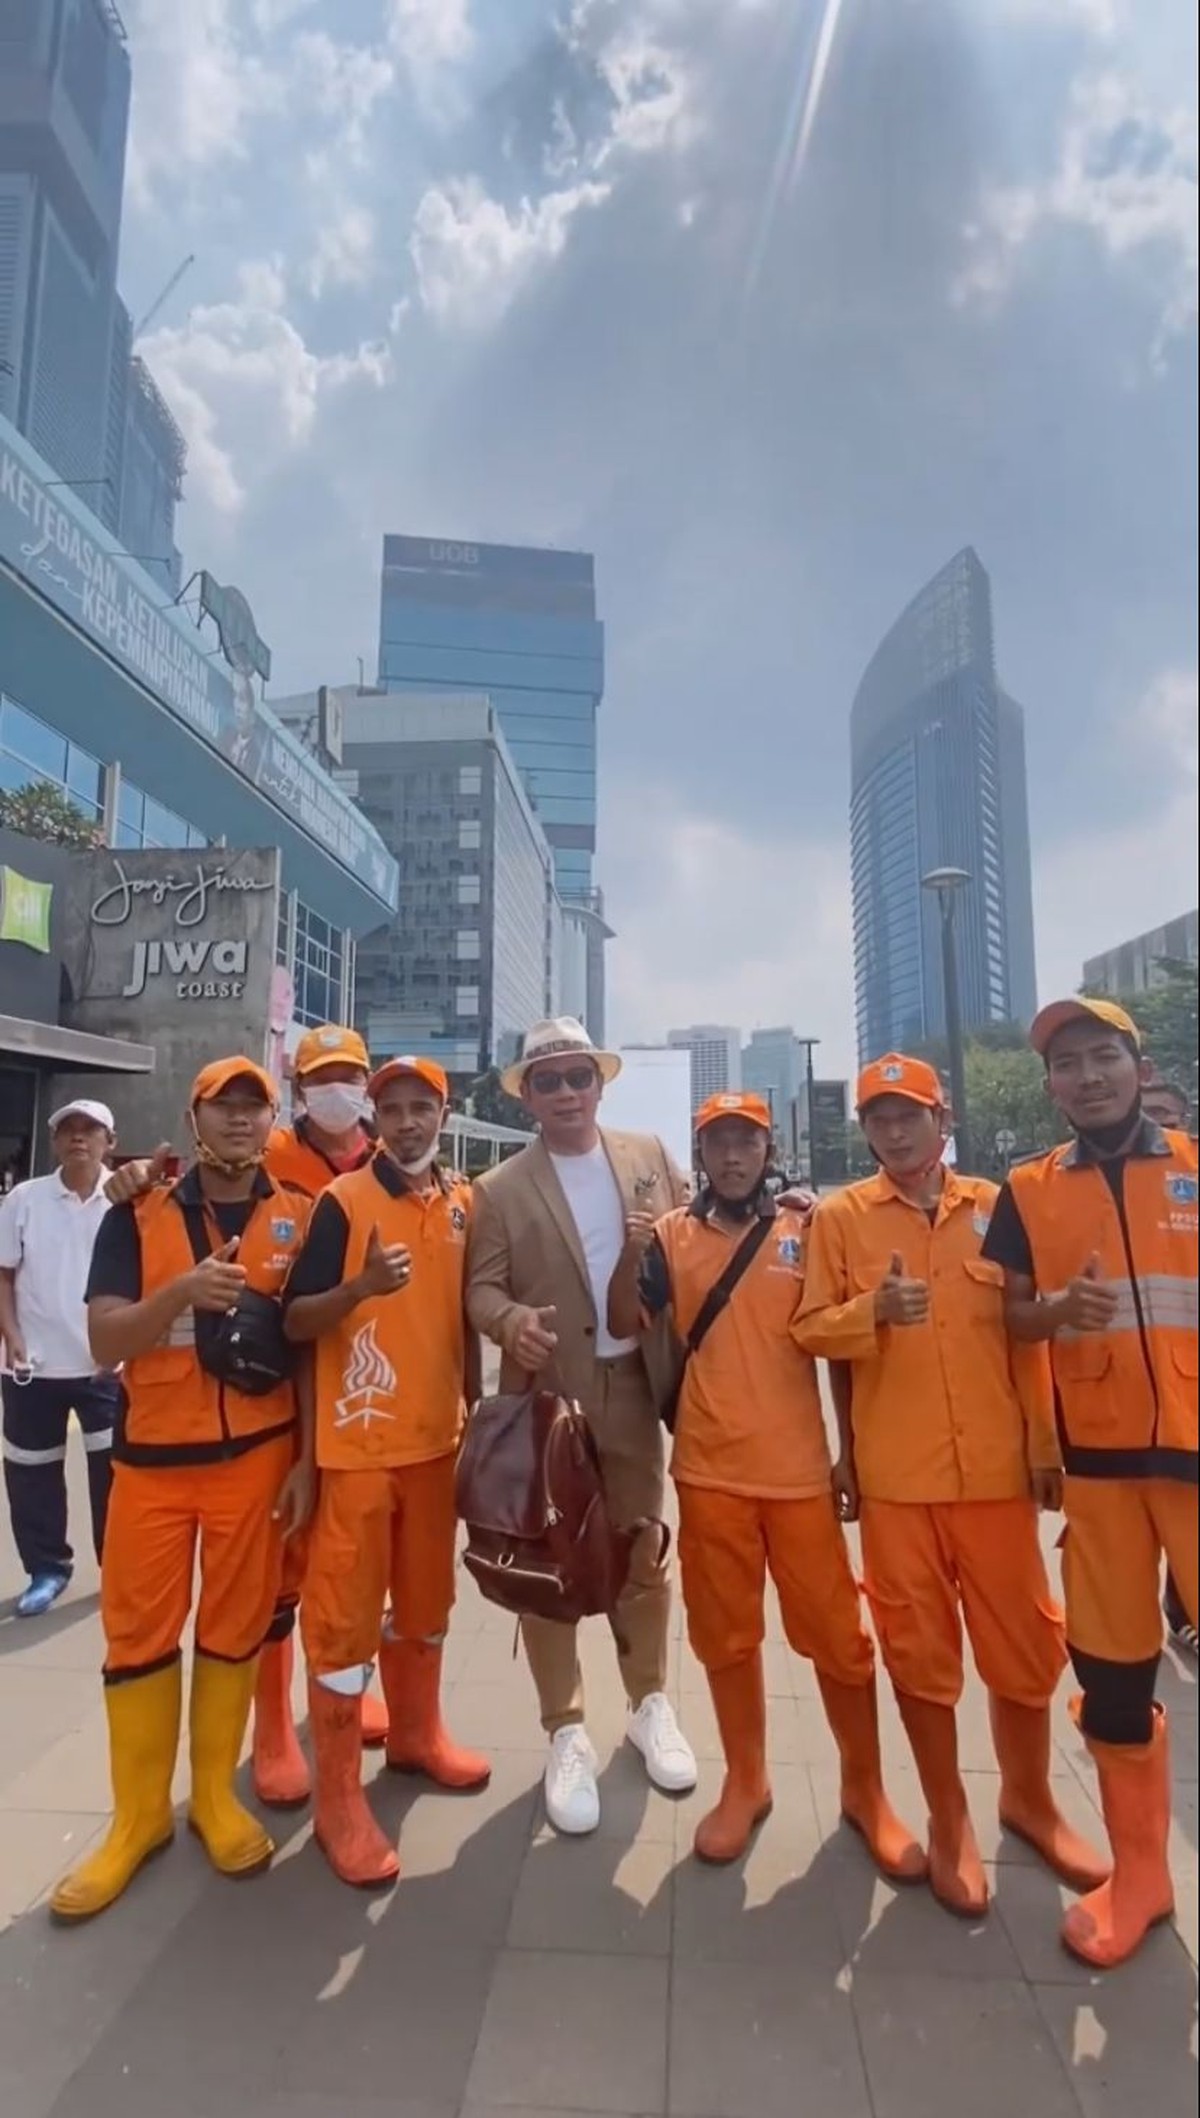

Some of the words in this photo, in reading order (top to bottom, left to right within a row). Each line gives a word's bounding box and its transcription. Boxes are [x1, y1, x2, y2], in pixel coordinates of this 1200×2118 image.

[429, 543, 480, 565] UOB
[127, 583, 208, 697] KETULUSAN
[175, 864, 274, 926] Jiwa
[176, 980, 244, 998] toast
